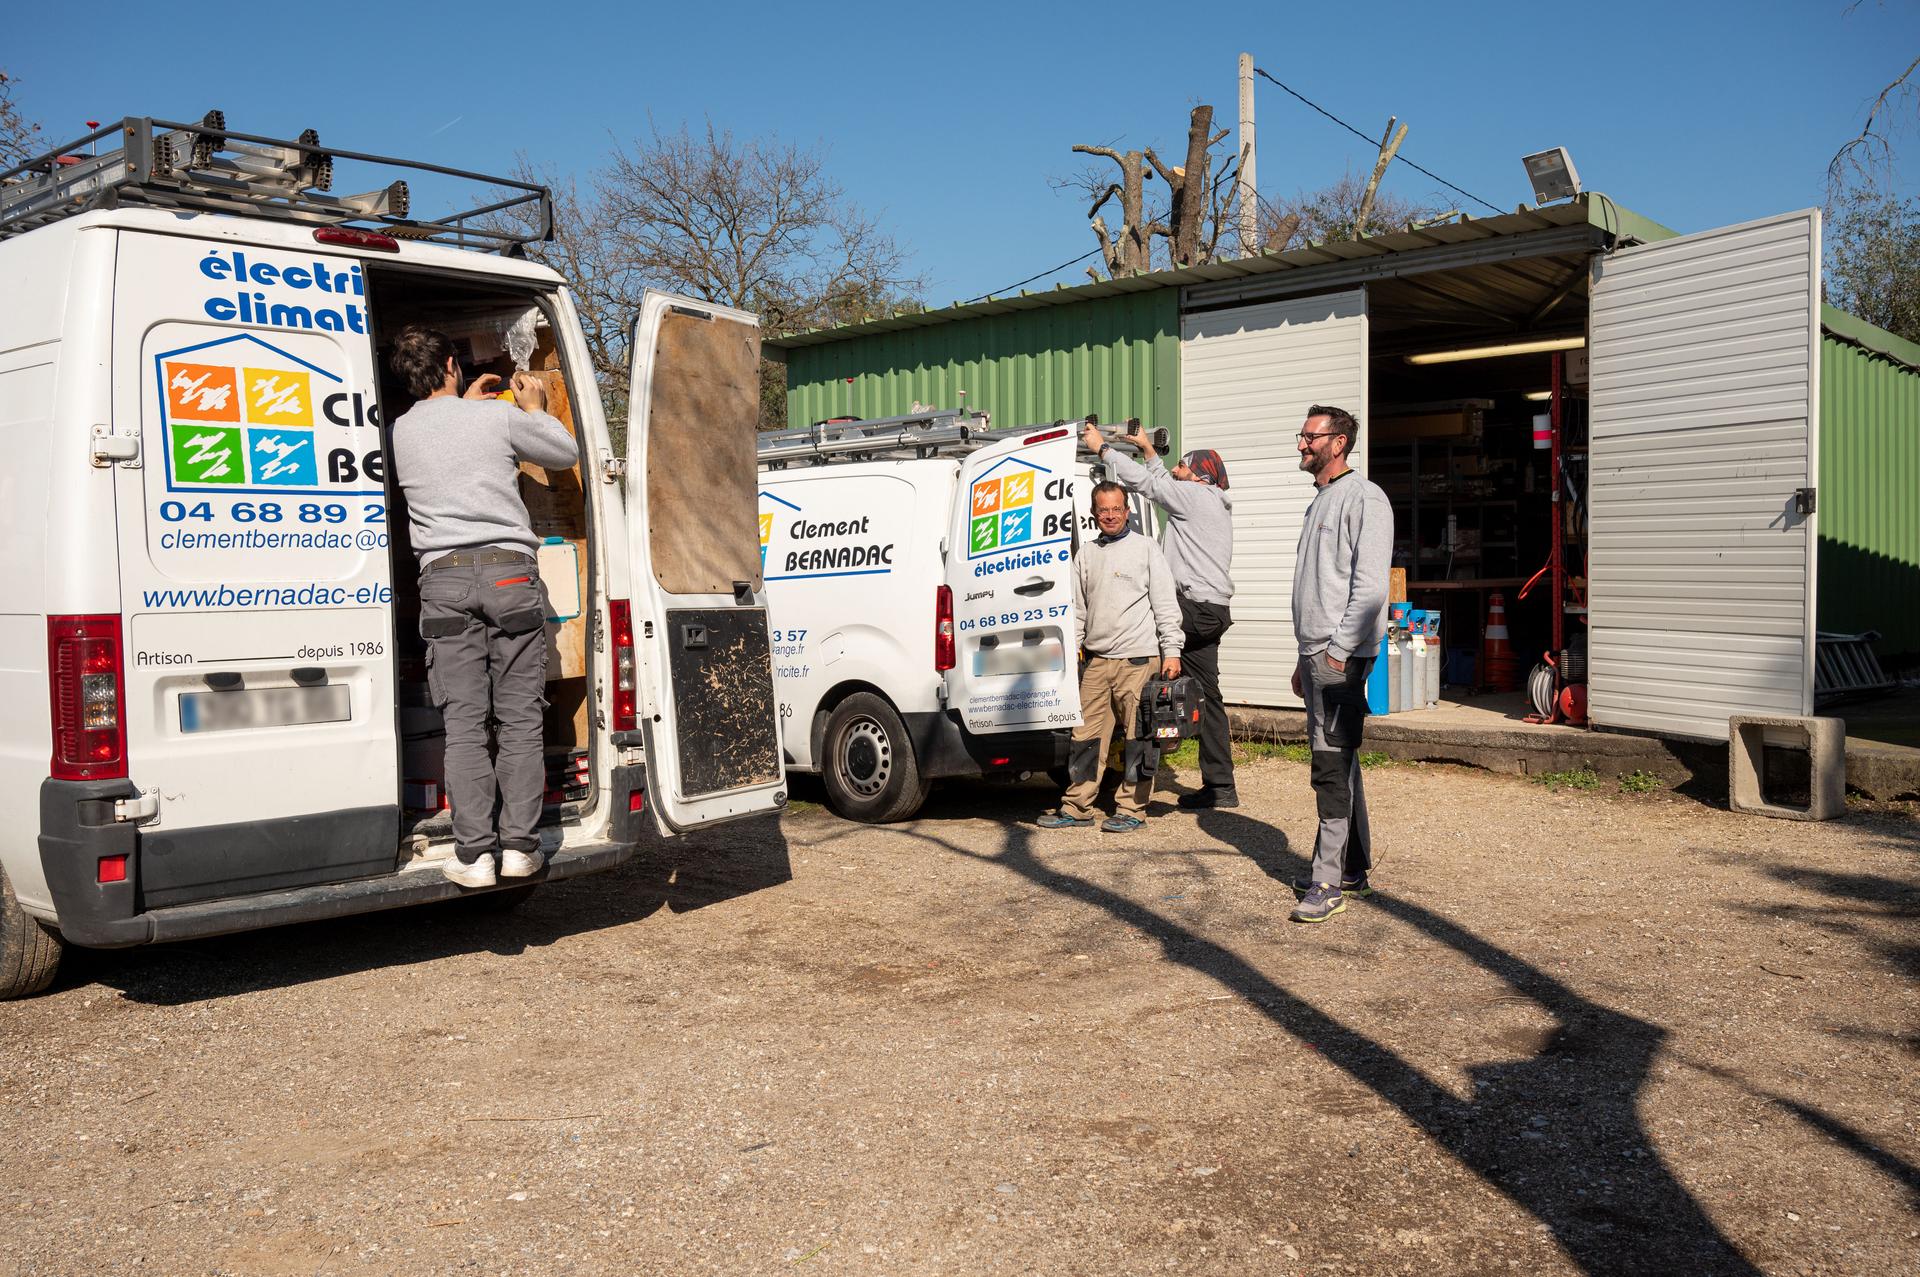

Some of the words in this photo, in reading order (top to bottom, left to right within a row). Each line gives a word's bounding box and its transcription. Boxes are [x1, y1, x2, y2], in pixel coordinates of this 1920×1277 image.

[199, 249, 365, 296] électri
[159, 501, 215, 522] 04
[231, 502, 282, 523] 68
[298, 503, 347, 523] 89
[363, 504, 386, 523] 2
[160, 528, 389, 551] clementbernadac@o
[790, 516, 869, 540] Clement
[785, 543, 894, 572] BERNADAC
[974, 549, 1053, 577] électricité
[143, 582, 392, 607] www.bernadac-ele
[964, 589, 994, 602] Jumpy
[960, 619, 975, 631] 04
[979, 616, 997, 628] 68
[1001, 612, 1019, 625] 89
[1023, 609, 1044, 621] 23
[1049, 604, 1069, 618] 57
[787, 629, 807, 642] 57
[136, 651, 193, 666] Artisan
[297, 644, 344, 661] depuis
[350, 642, 384, 656] 1986
[776, 664, 809, 678] ricite.fr
[968, 719, 994, 728] Artisan
[1047, 713, 1077, 723] depuis
